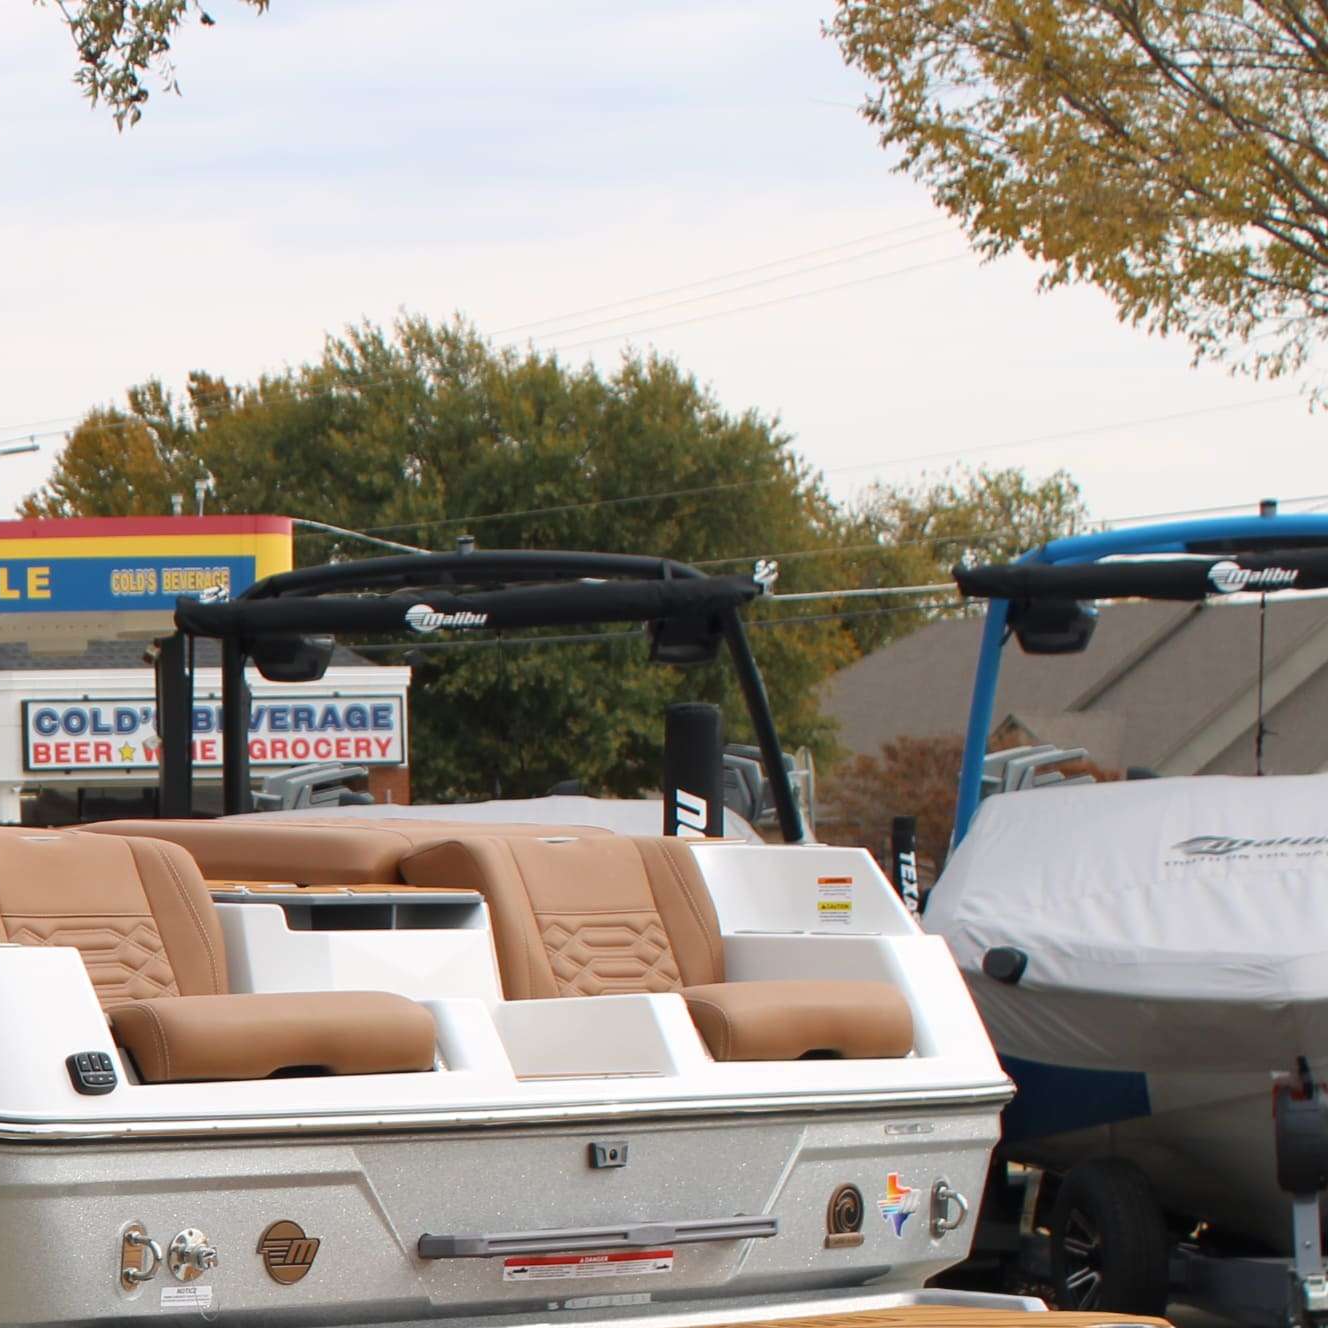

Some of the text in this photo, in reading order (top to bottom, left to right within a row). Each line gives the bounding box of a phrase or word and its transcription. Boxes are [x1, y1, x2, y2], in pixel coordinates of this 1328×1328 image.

[111, 567, 231, 595] COLD'S BEVERAGE
[1227, 567, 1300, 584] Malibu
[421, 611, 489, 627] Malibu
[32, 706, 159, 736] COLD'
[32, 736, 394, 764] BEER GROCERY
